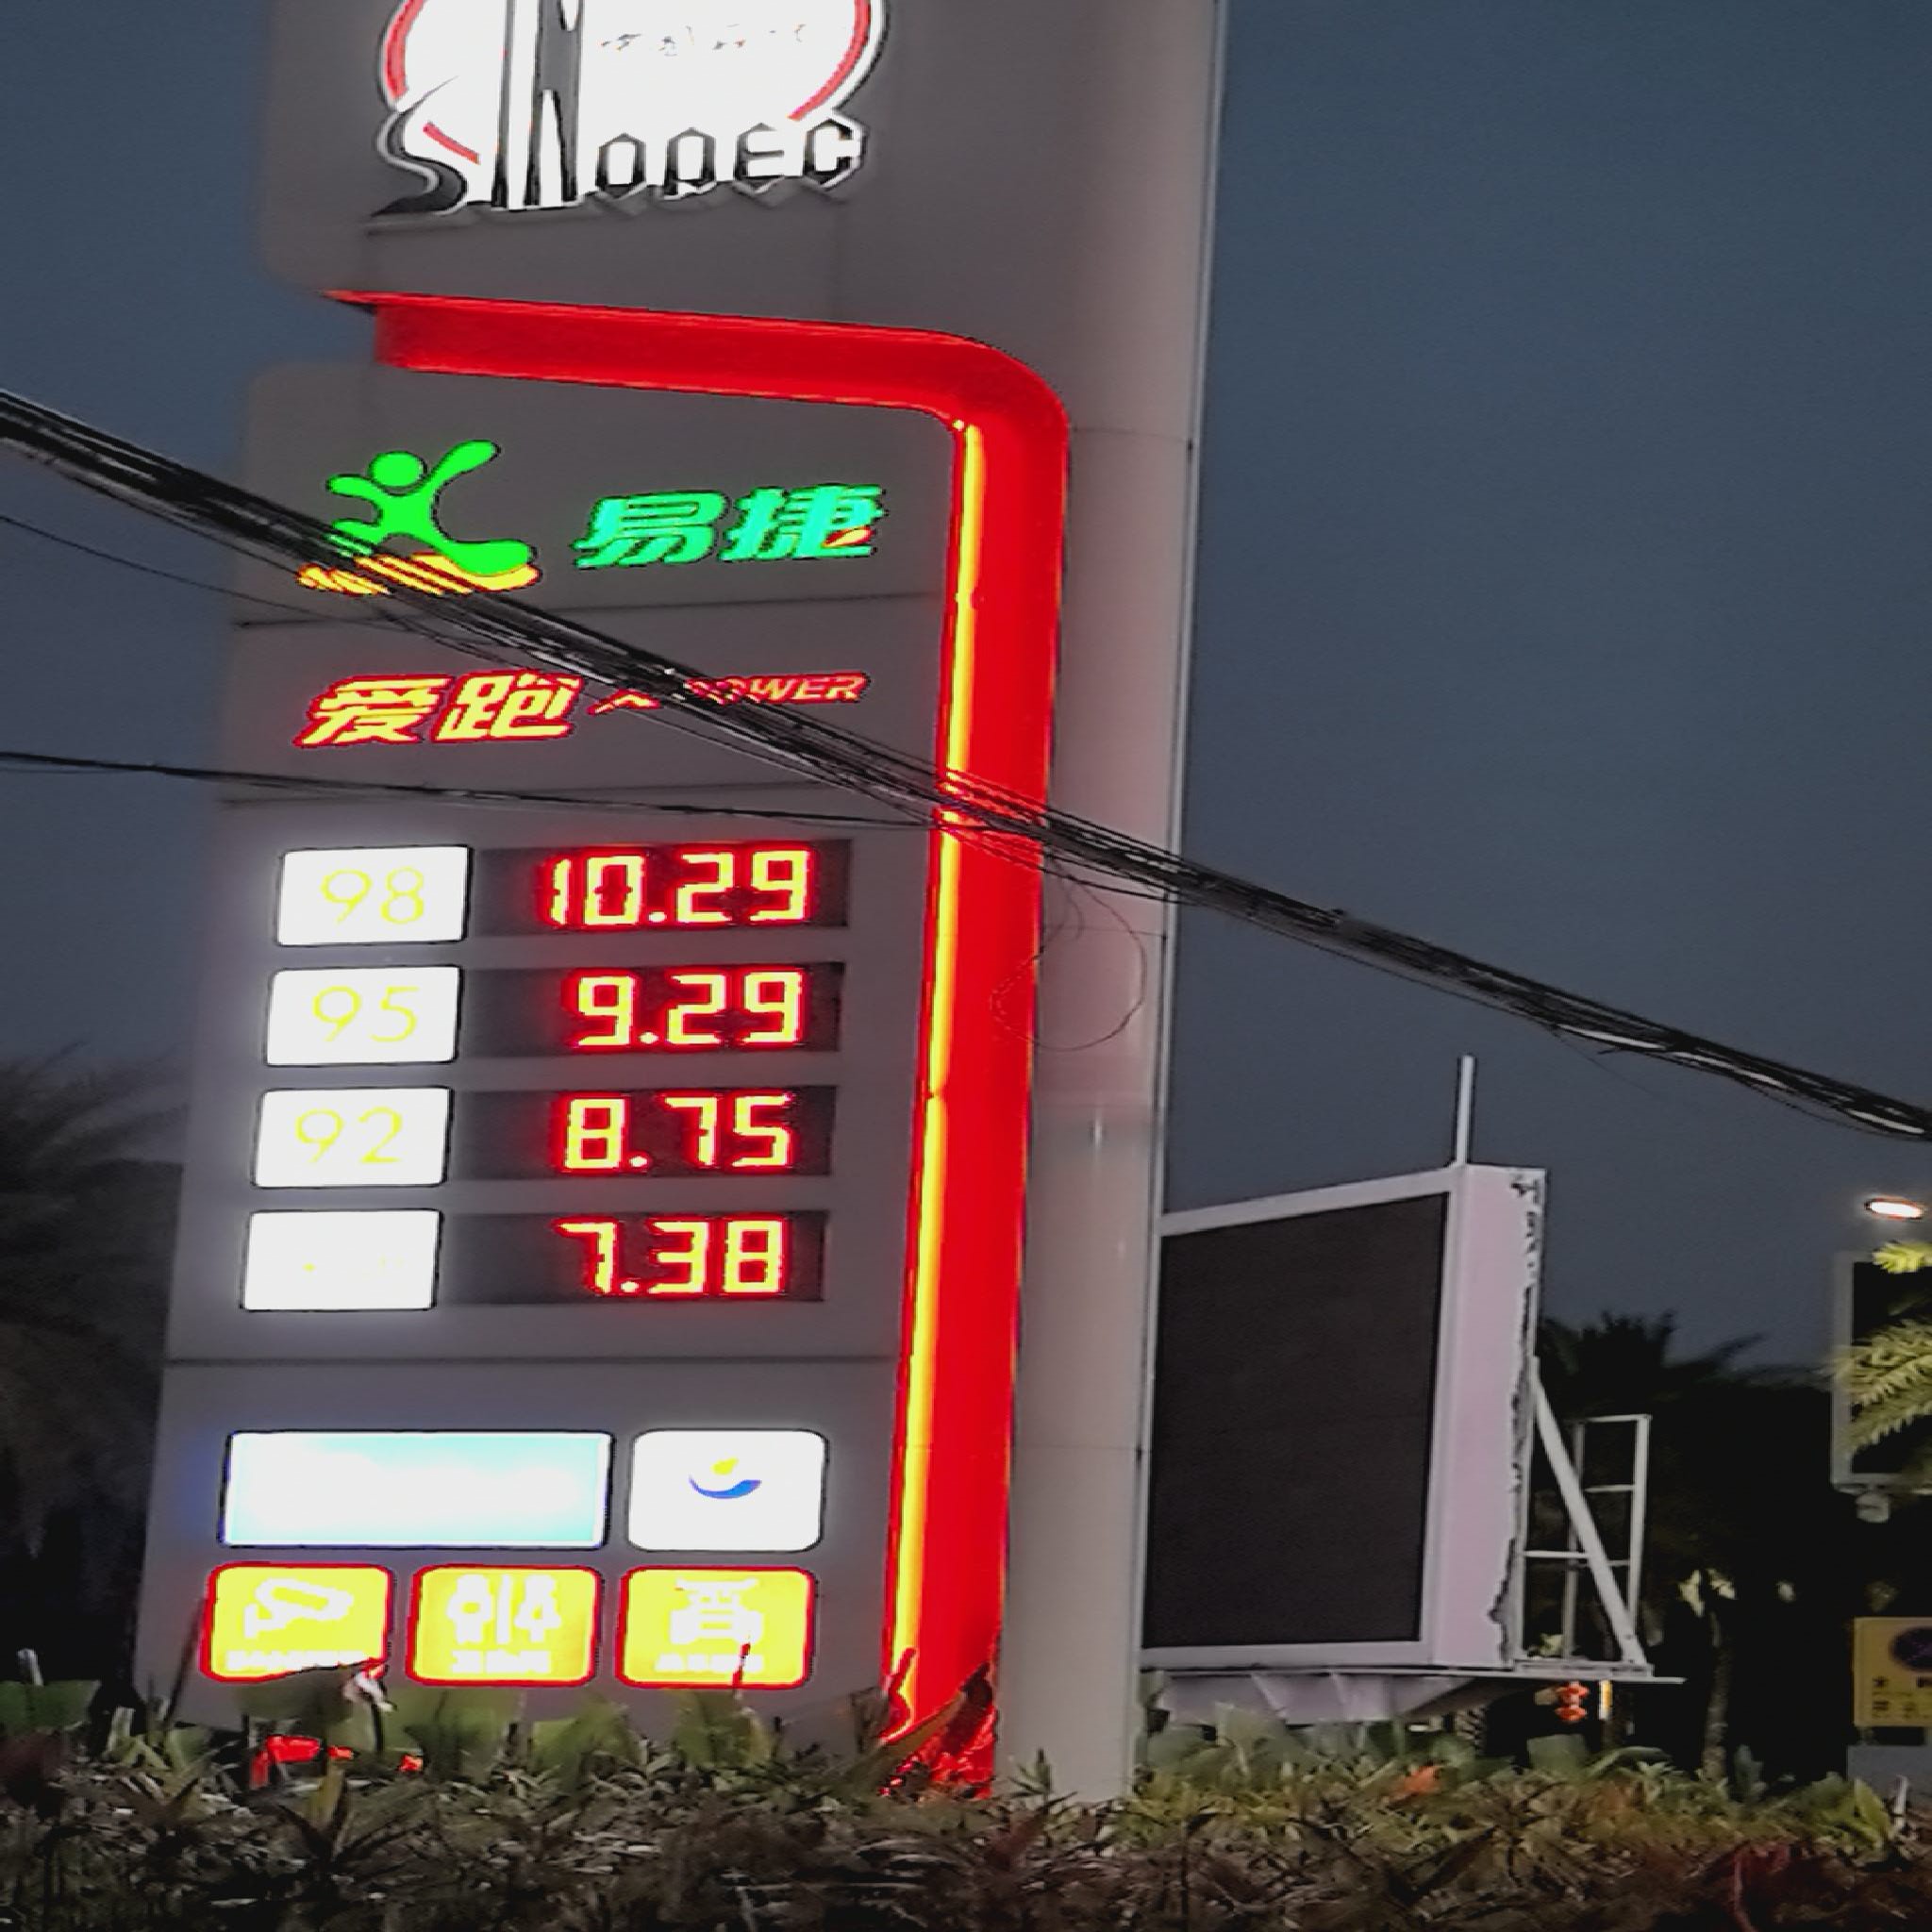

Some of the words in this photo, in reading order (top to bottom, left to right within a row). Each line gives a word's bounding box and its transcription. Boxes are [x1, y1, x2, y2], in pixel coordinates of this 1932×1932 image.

[574, 484, 886, 568] 易捷
[294, 671, 585, 748] 爱跑
[320, 865, 425, 925] 98
[547, 847, 811, 928] 10.29
[312, 985, 420, 1043] 95
[572, 970, 804, 1048] 9.29
[295, 1106, 404, 1165] 92
[562, 1092, 795, 1173] 8.75
[557, 1217, 787, 1298] 7.38
